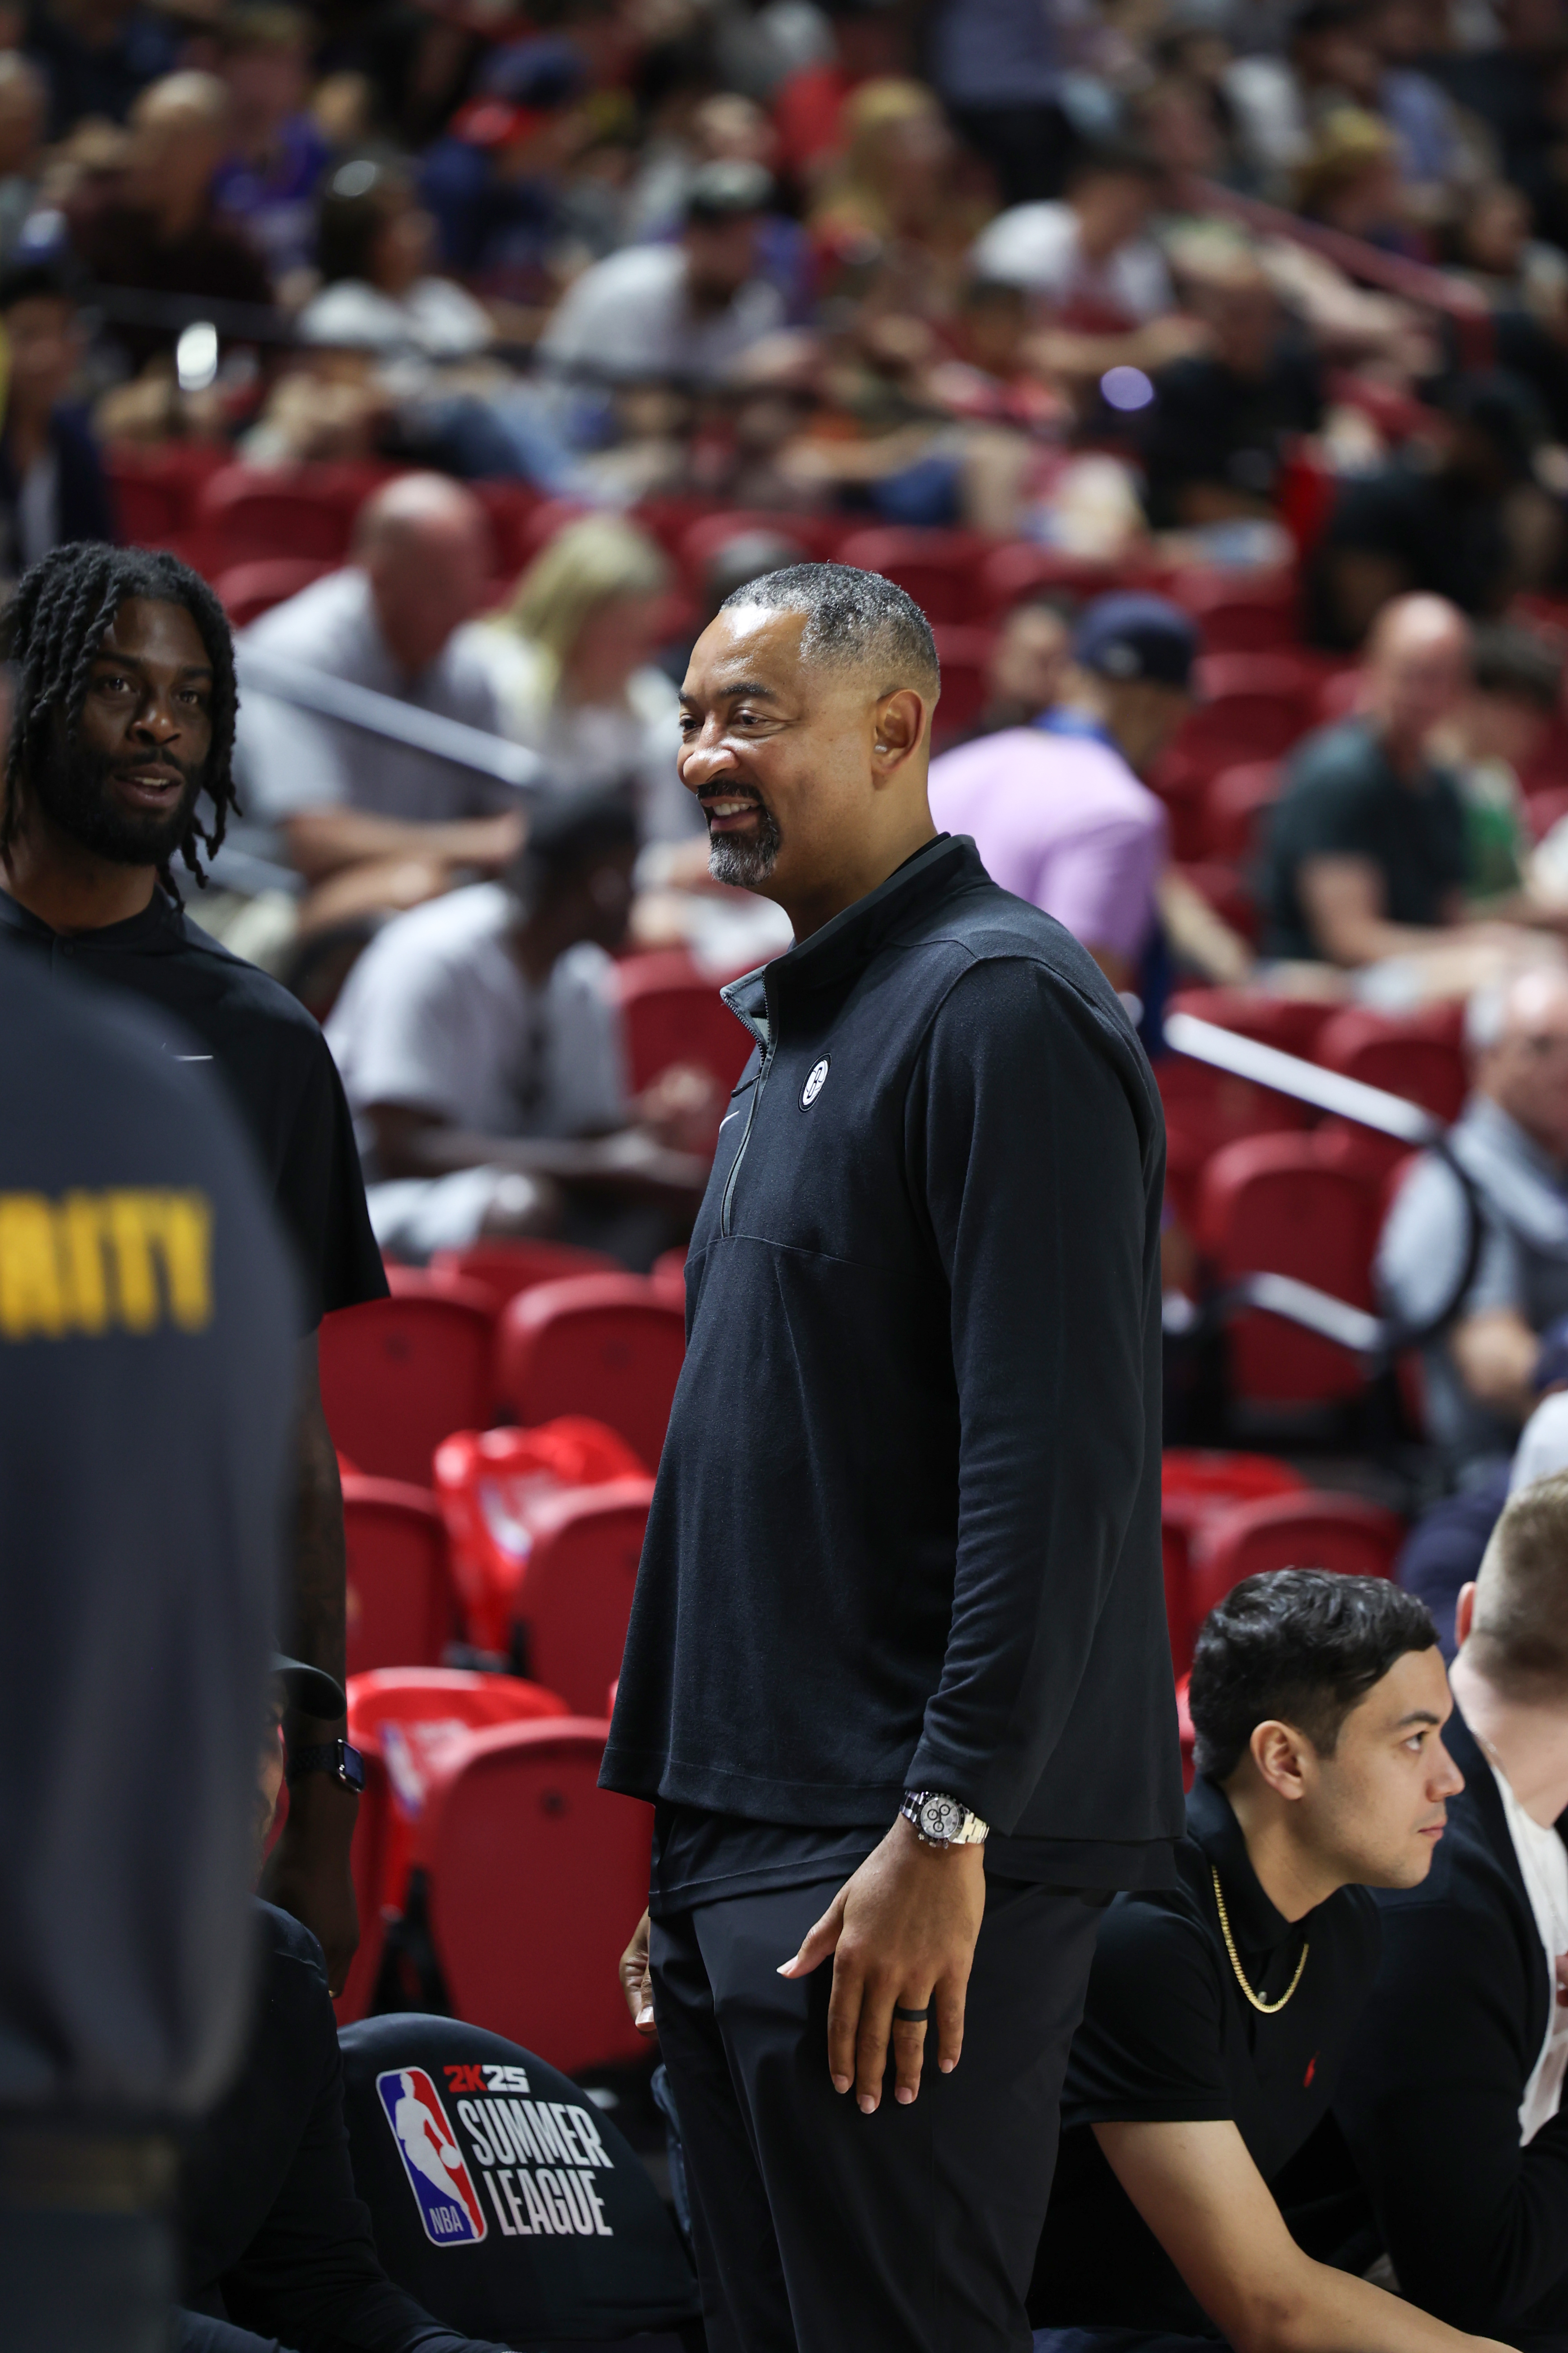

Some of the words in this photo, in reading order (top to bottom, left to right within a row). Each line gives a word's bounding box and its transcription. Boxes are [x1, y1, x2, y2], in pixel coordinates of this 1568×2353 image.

[443, 2064, 531, 2093] 2K25
[456, 2099, 615, 2169] SUMMER
[429, 2206, 464, 2235] NBA
[483, 2169, 613, 2236] LEAGUE
